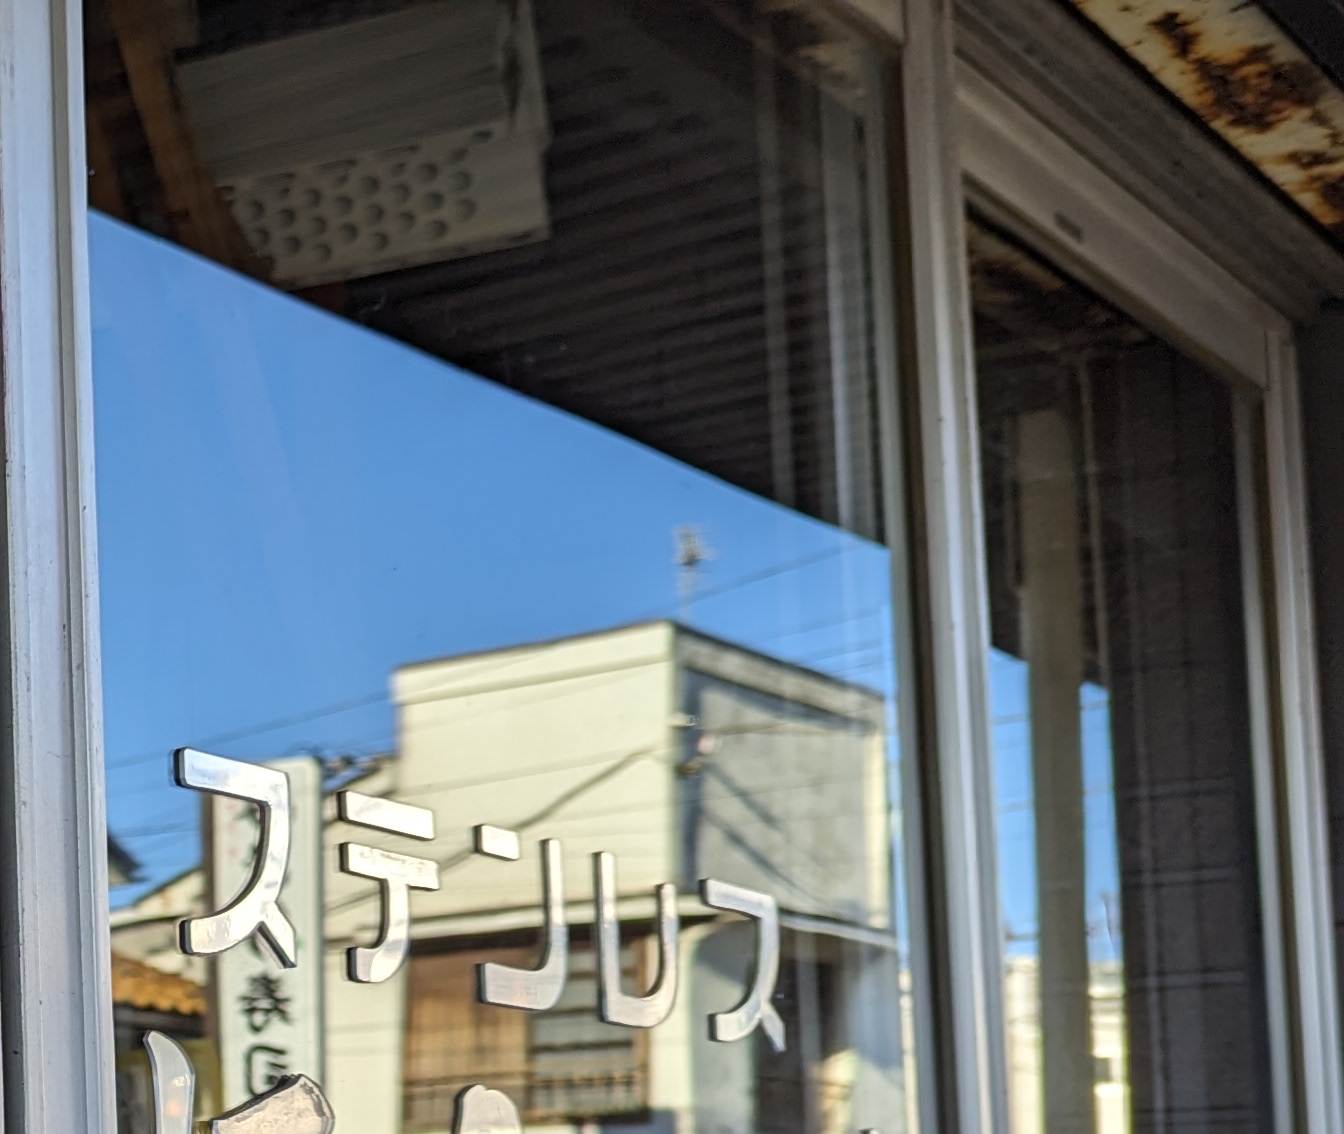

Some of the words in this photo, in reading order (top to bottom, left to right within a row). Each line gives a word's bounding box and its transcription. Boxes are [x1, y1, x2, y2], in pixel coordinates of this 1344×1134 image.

[174, 747, 787, 1052] ステンレス
